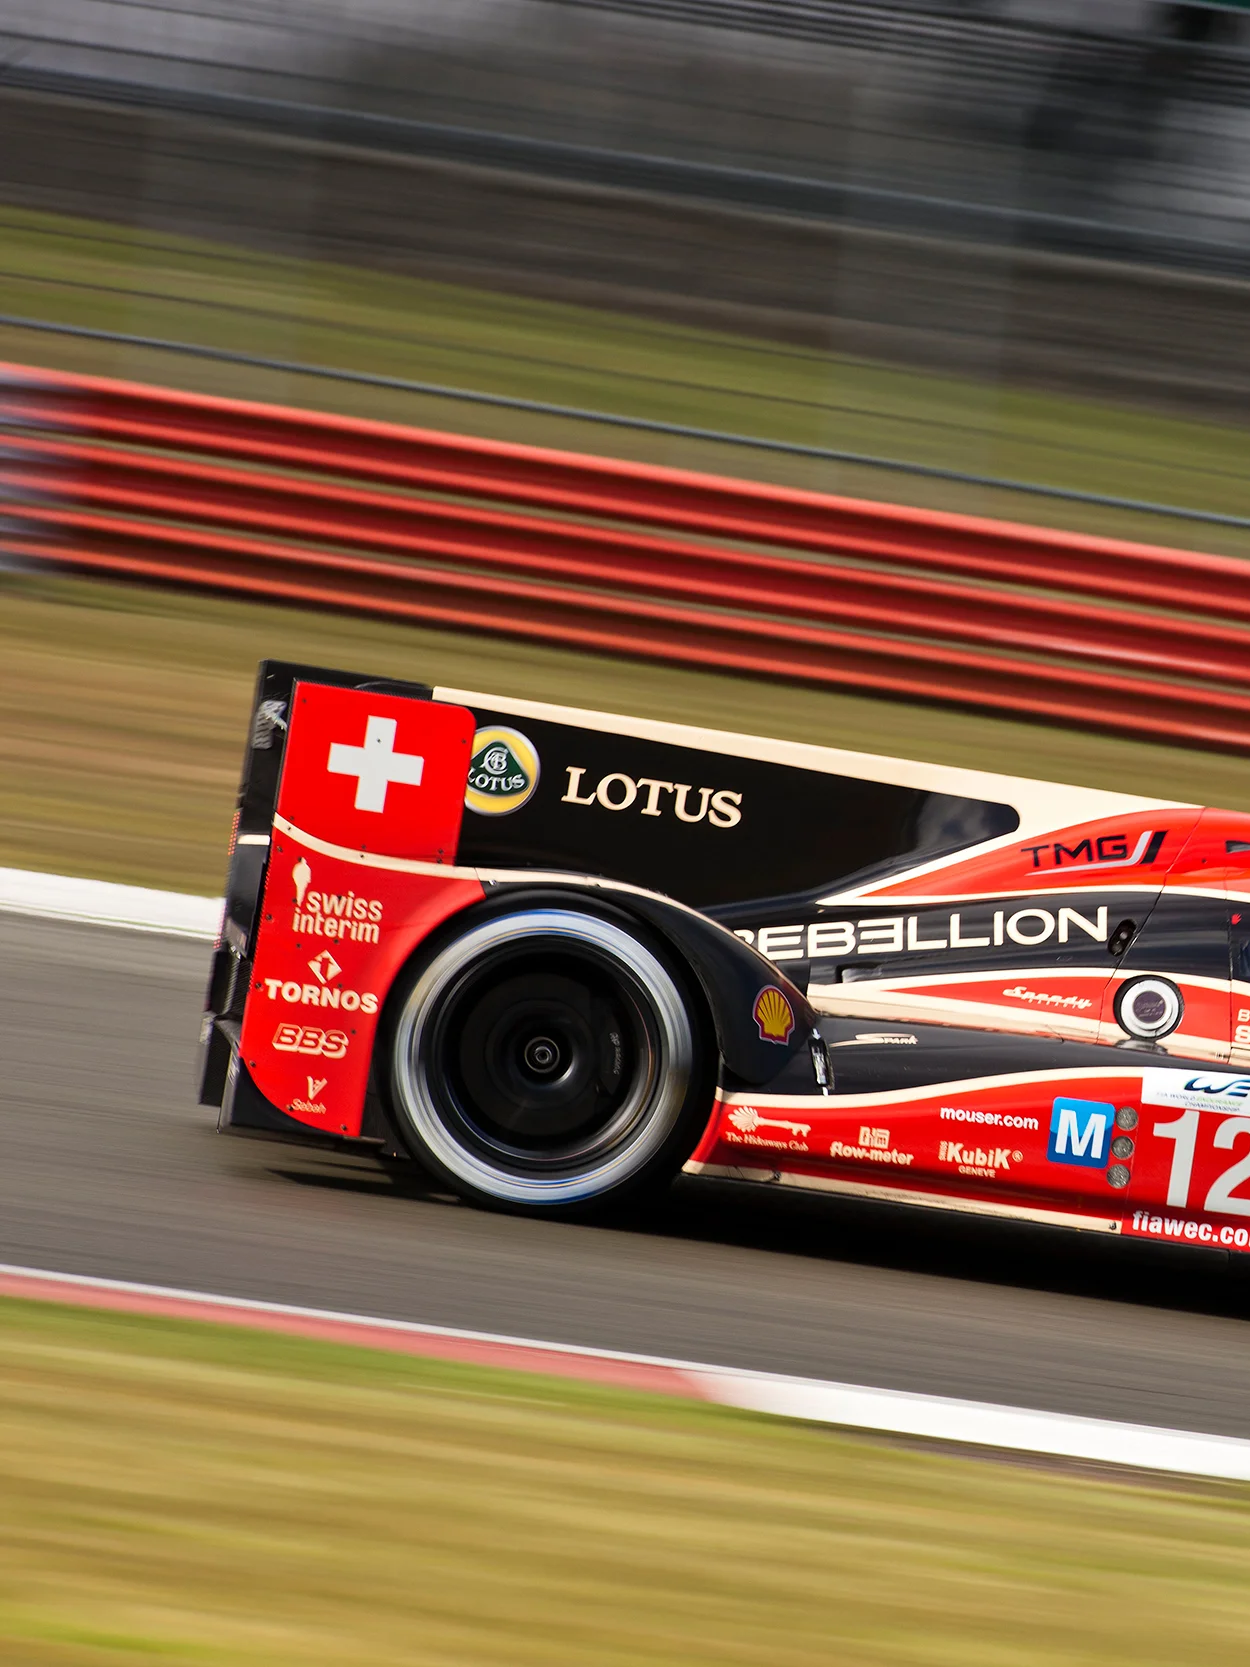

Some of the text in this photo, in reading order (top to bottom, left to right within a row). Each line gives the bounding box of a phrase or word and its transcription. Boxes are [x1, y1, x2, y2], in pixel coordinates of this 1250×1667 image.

[467, 768, 526, 792] LOTUS
[561, 765, 743, 828] LOTUS
[1021, 834, 1127, 867] TMG
[306, 890, 384, 922] swiss
[292, 907, 380, 944] interim
[264, 978, 379, 1014] TORNOS
[1002, 986, 1093, 1010] Speedy
[271, 1022, 350, 1059] BBS
[940, 1107, 1039, 1130] mouser.com
[1055, 1108, 1107, 1159] M
[725, 1131, 743, 1143] The
[789, 1139, 809, 1152] Club
[829, 1141, 914, 1166] flow-meter
[958, 1165, 996, 1178] GENEVE
